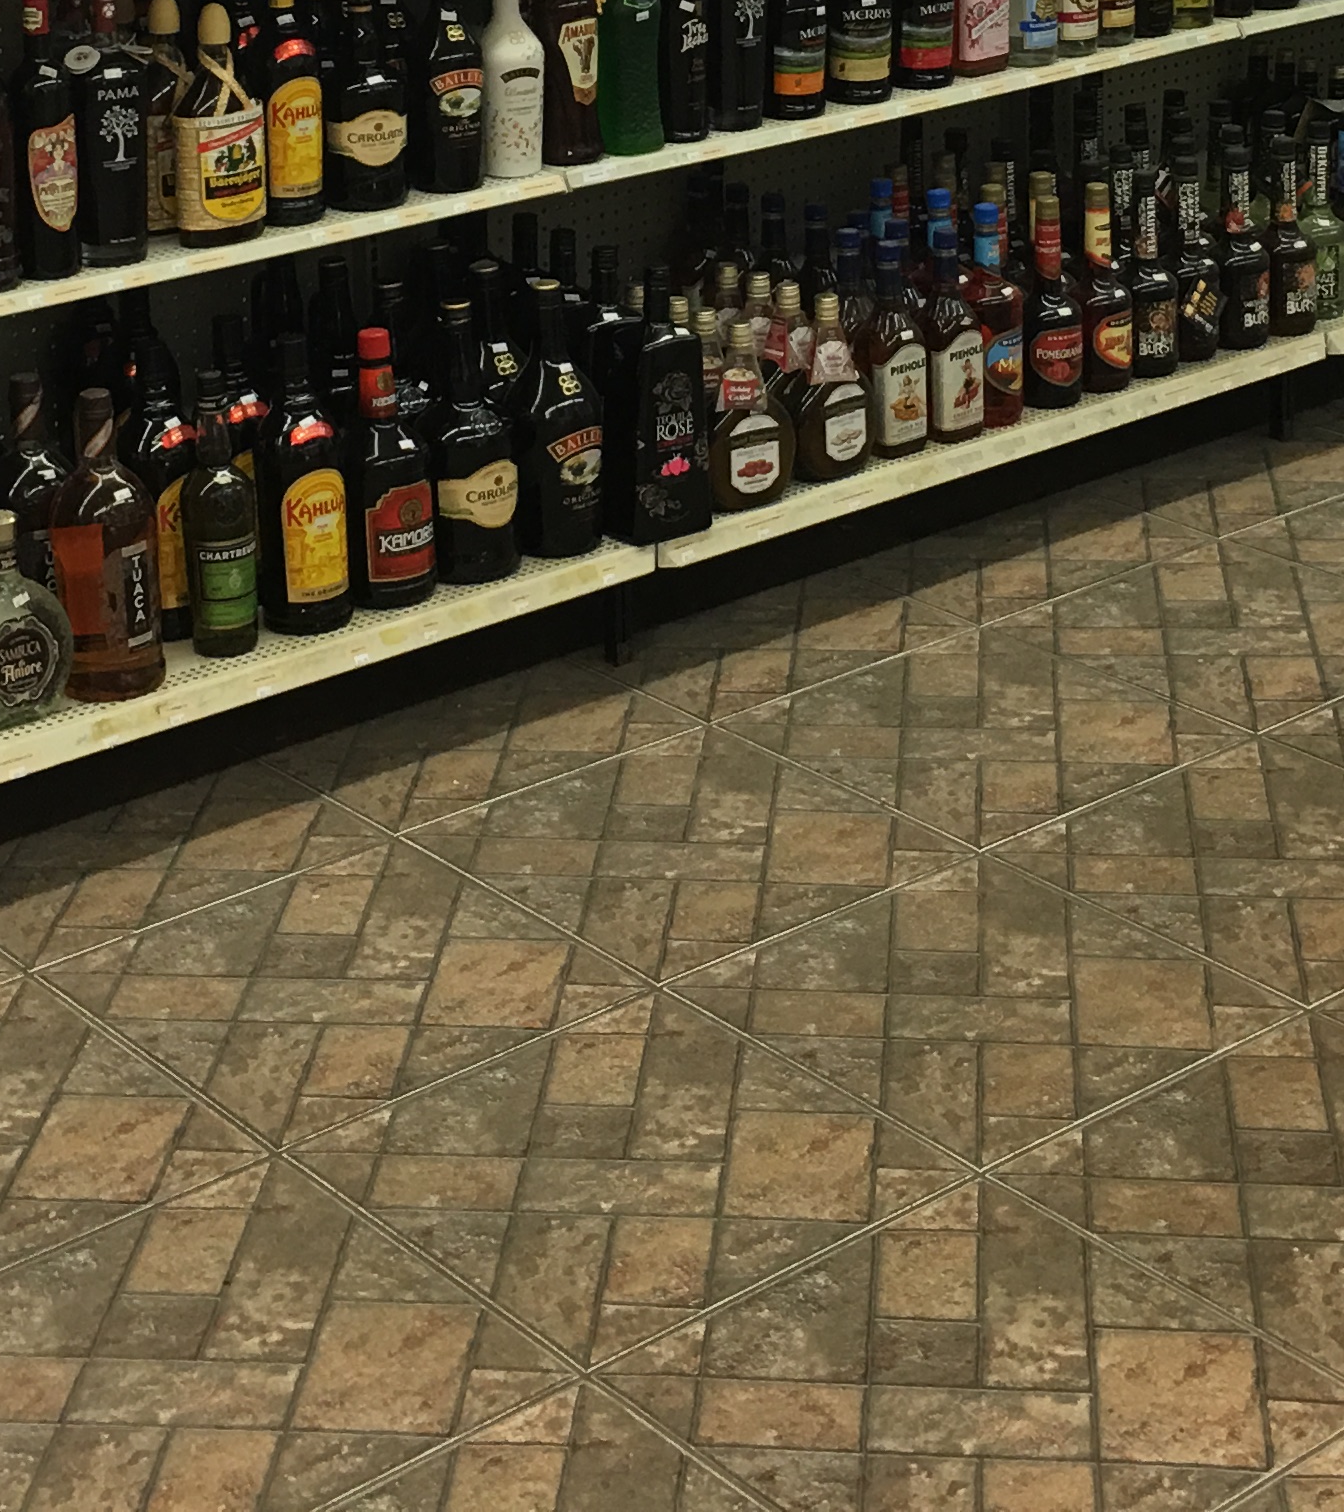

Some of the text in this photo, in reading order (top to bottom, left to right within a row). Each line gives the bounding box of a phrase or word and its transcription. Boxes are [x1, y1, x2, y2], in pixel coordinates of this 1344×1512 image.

[842, 8, 892, 23] MERRYS
[97, 85, 140, 102] PAMA
[949, 344, 984, 362] PIEHOLE
[890, 356, 927, 377] PIEHOLE
[656, 408, 695, 426] TEQUILA
[656, 419, 695, 442] ROSE
[130, 555, 147, 625] TUACA
